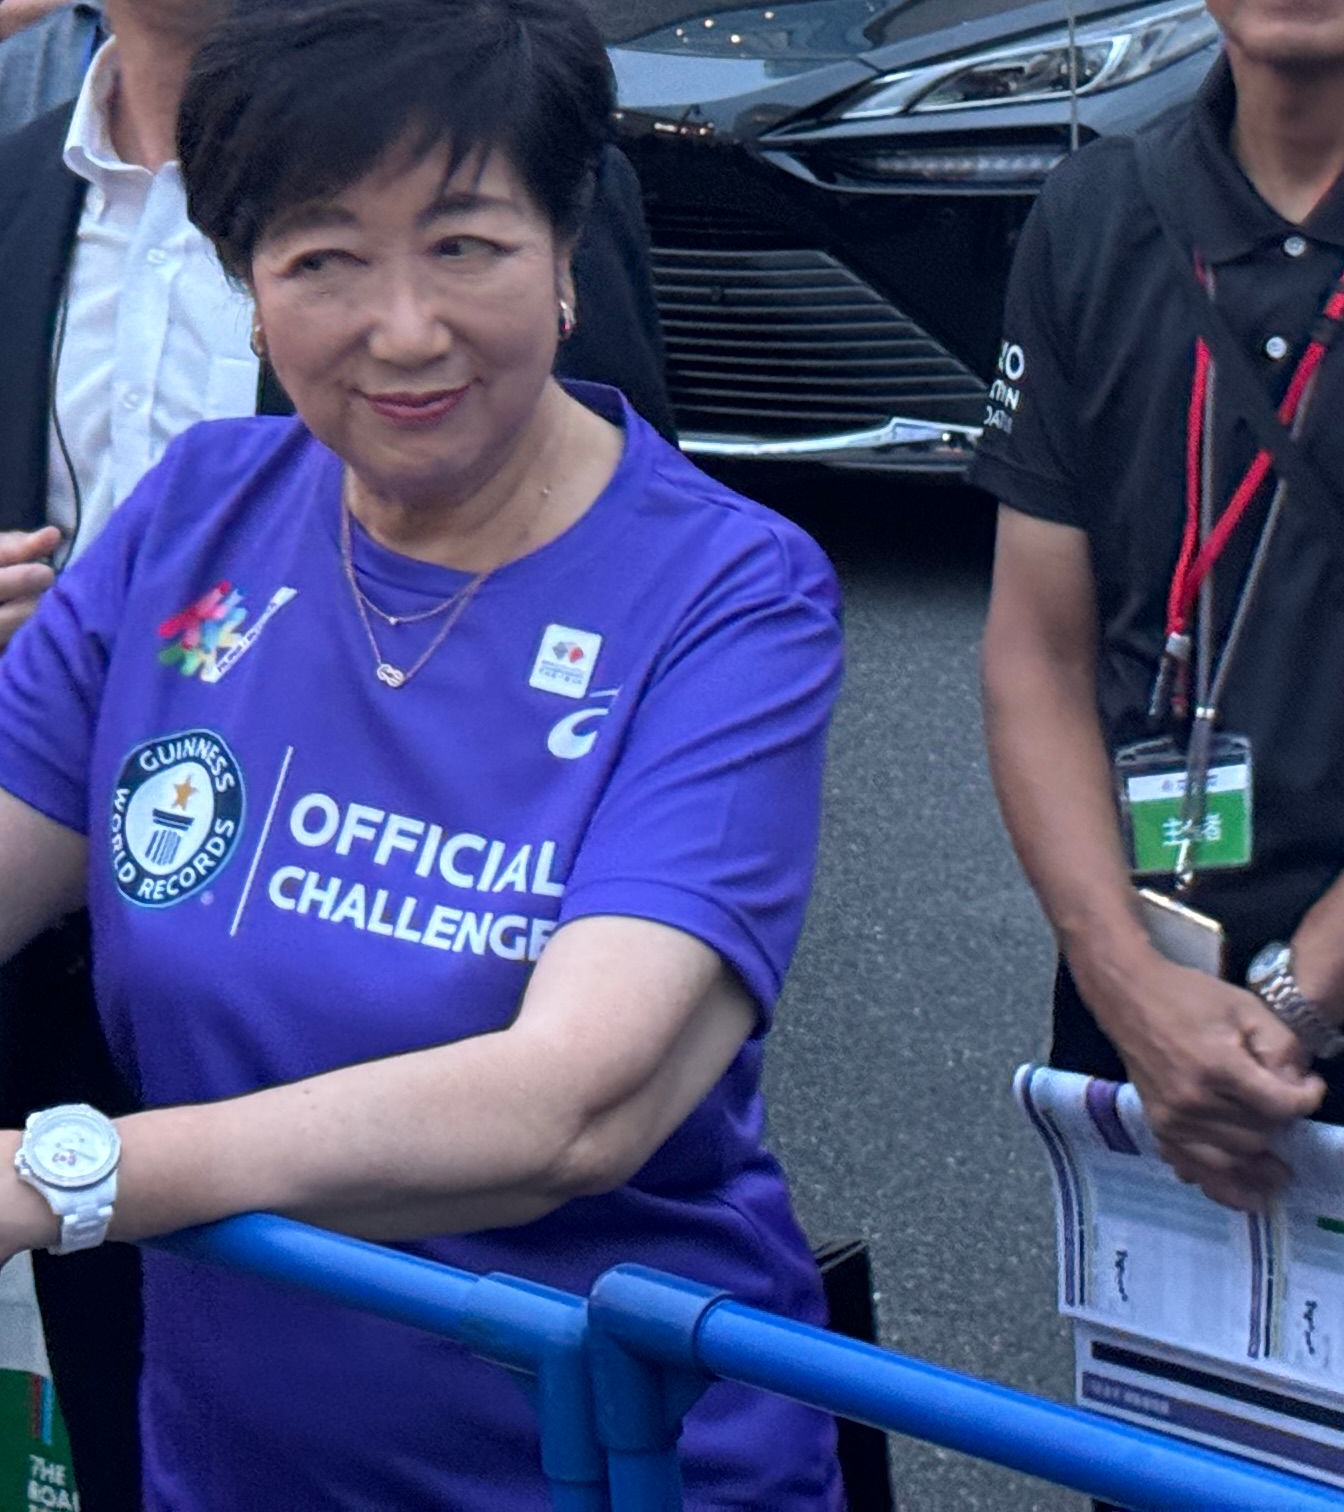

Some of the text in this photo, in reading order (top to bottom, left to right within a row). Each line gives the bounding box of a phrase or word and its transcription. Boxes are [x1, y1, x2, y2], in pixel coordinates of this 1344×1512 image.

[139, 737, 236, 793] GUINNESS
[111, 787, 235, 901] WORLD RECORDS
[289, 792, 566, 898] OFFICIAL
[29, 1453, 66, 1487] THE
